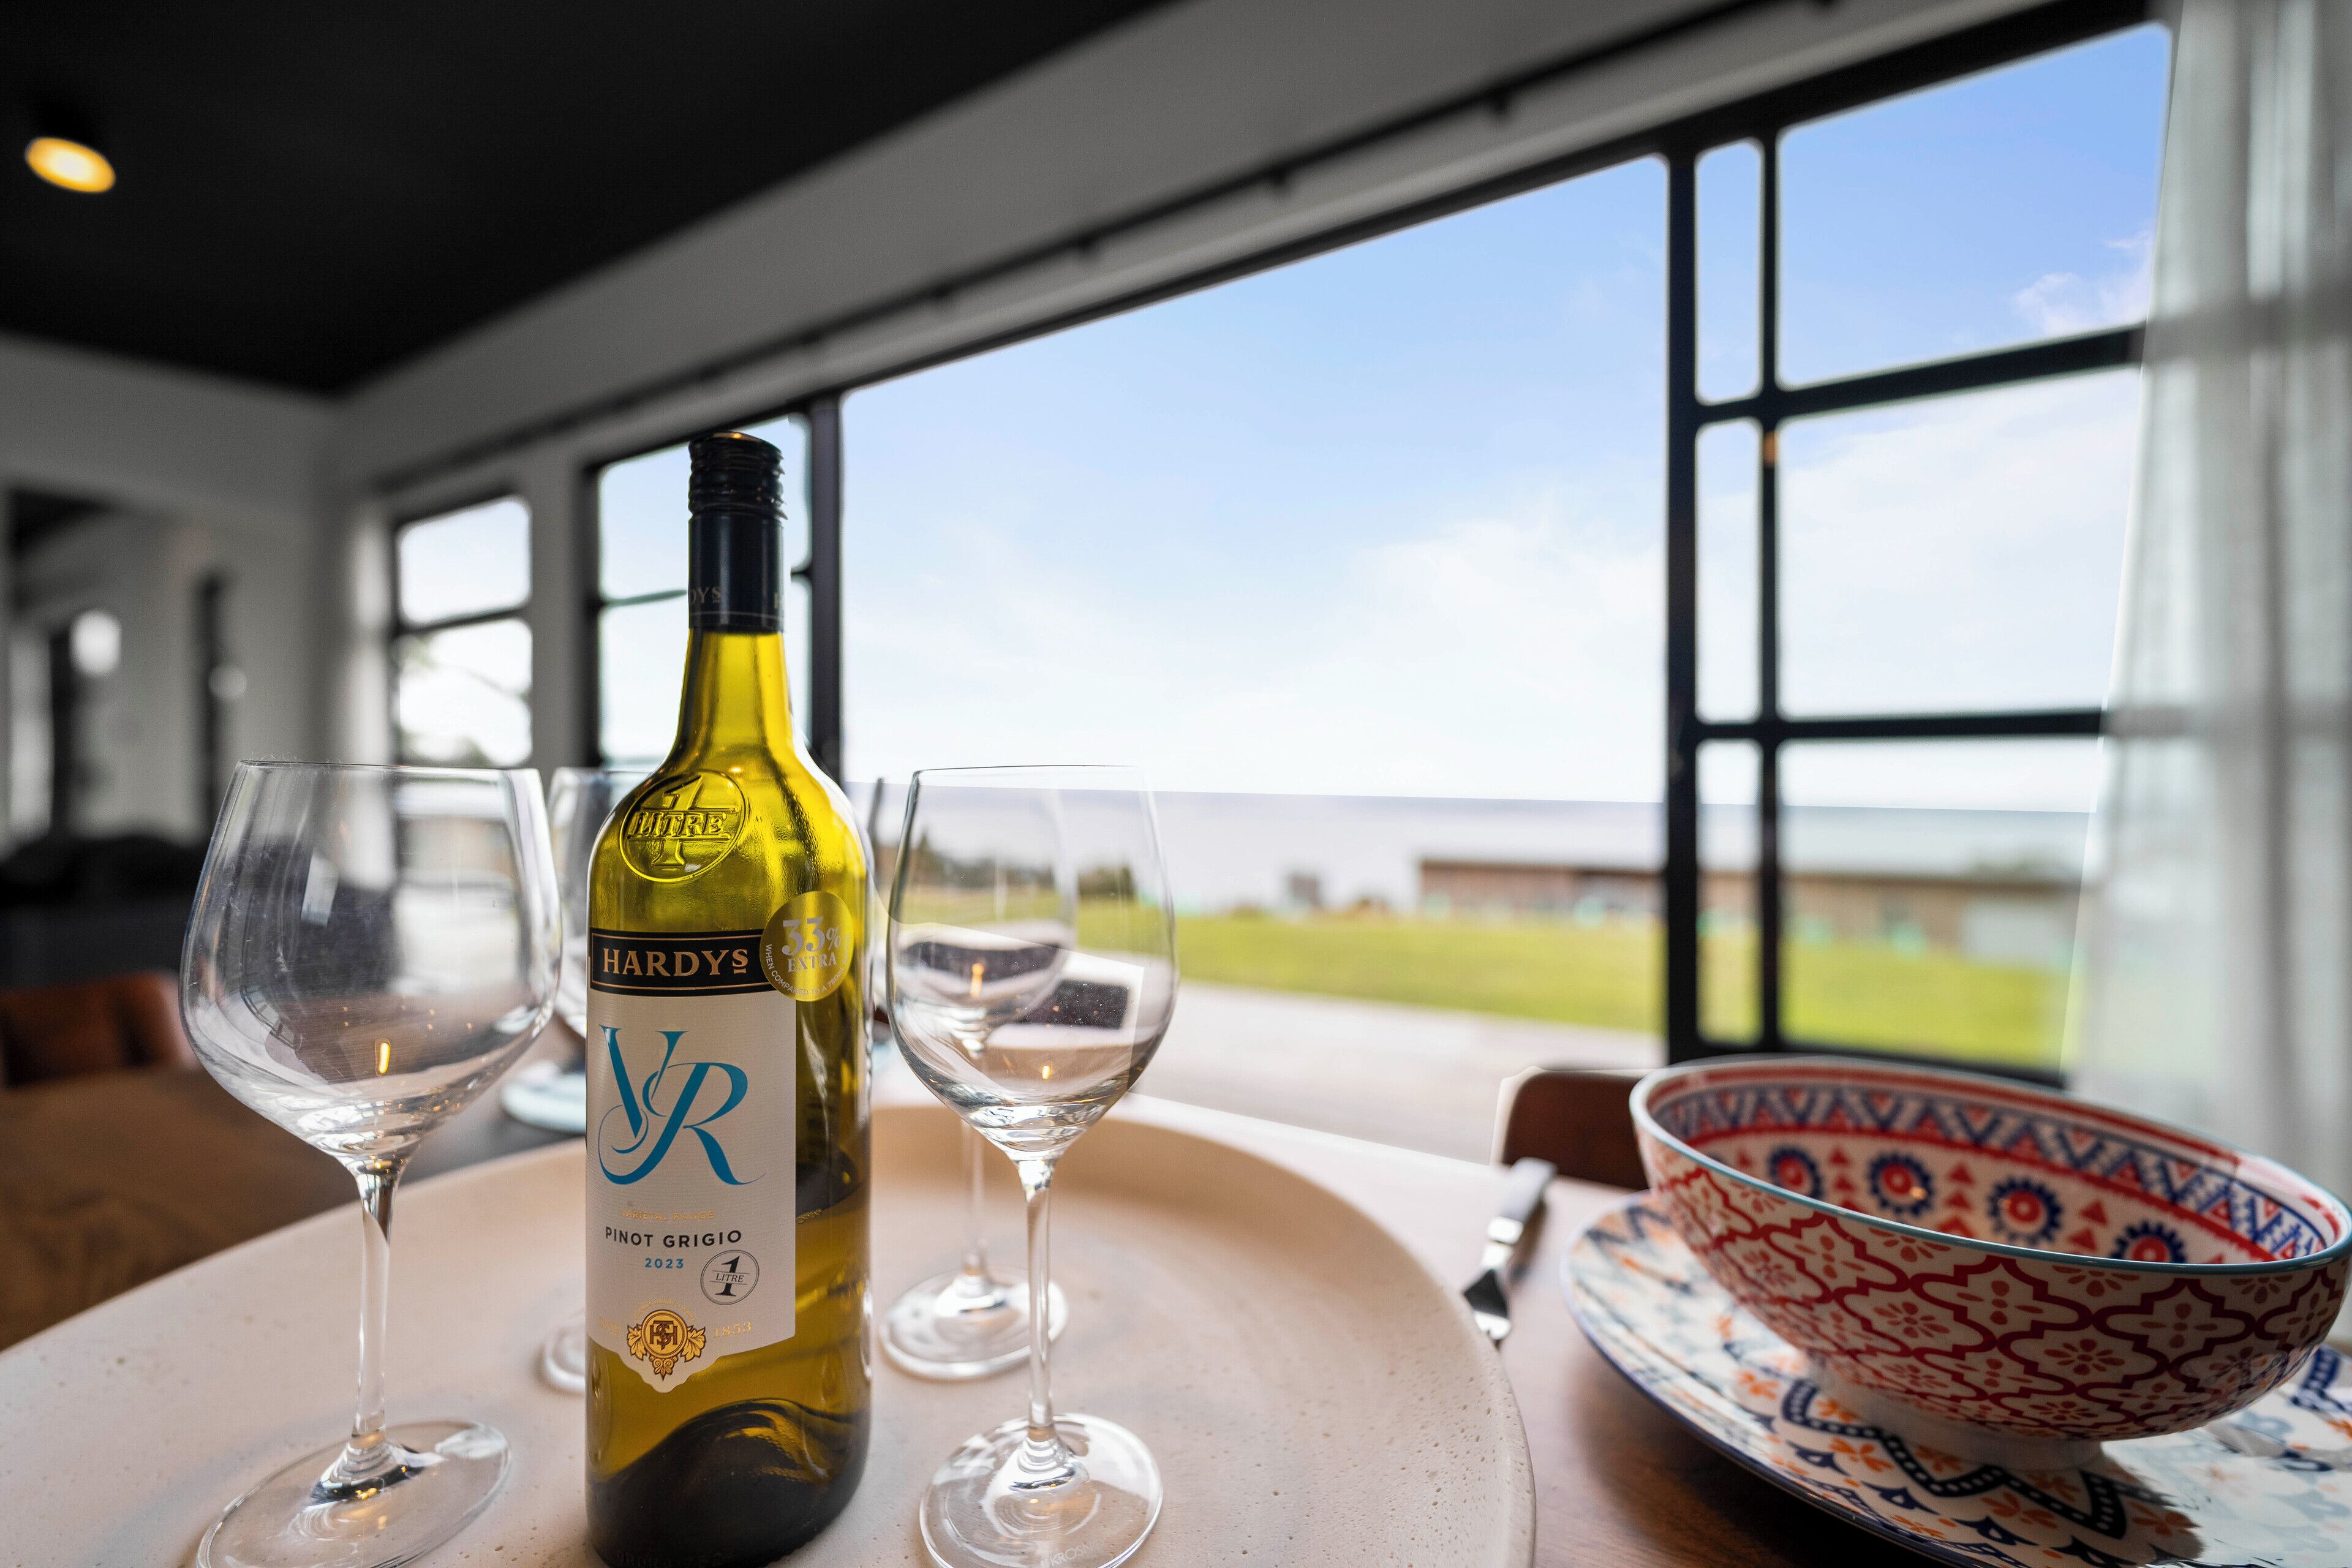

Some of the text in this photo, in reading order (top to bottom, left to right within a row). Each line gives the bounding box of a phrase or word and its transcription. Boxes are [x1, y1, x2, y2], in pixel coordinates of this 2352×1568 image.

[630, 811, 726, 837] LITRE
[651, 774, 703, 867] 1
[782, 916, 842, 956] 33%
[603, 948, 748, 976] HARDYS
[766, 944, 774, 970] WHEN
[788, 952, 837, 973] EXTRA
[605, 1226, 742, 1248] PINOT GRIGIO
[644, 1257, 684, 1269] 2023
[715, 1256, 741, 1297] 1
[715, 1273, 745, 1283] LITRE
[714, 1321, 752, 1339] 1853
